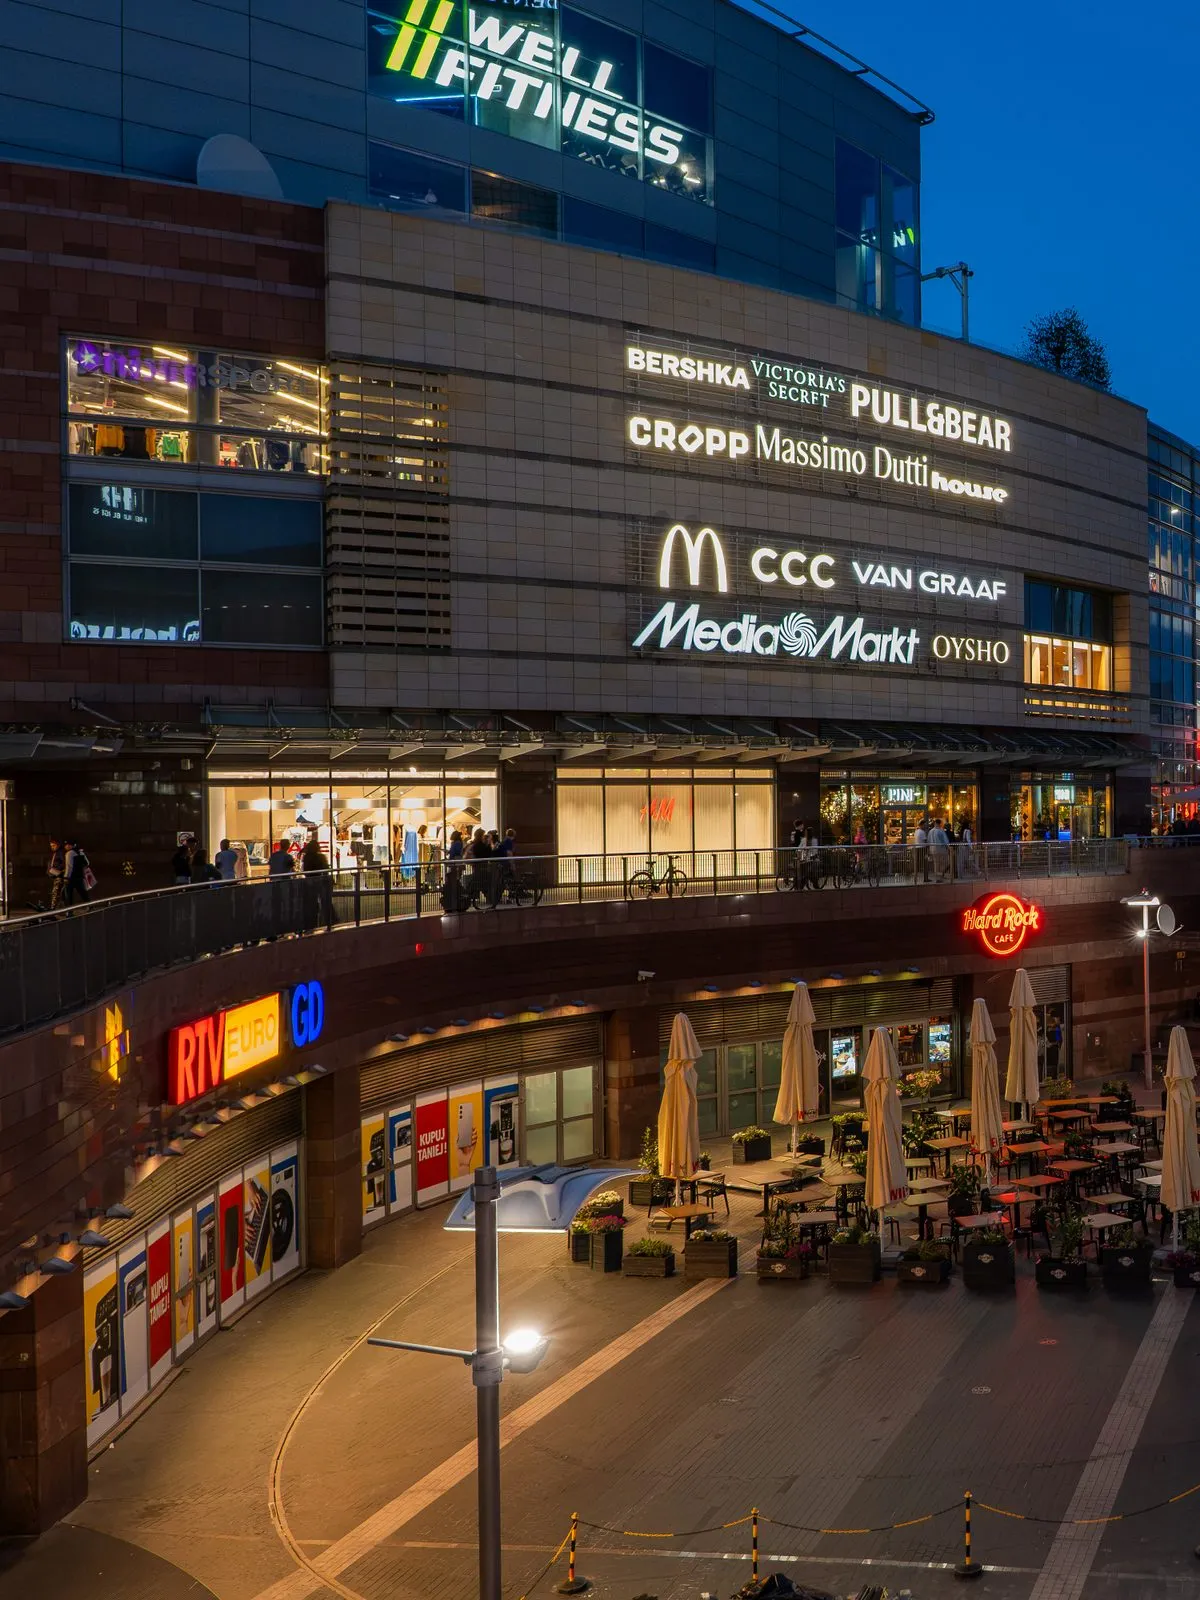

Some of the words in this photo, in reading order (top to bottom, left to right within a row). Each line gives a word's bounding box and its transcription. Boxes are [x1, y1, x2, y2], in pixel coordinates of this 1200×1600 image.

[468, 9, 624, 100] WELL
[435, 48, 684, 165] FITNESS
[626, 347, 750, 389] BERSHKA
[750, 359, 846, 393] VICTORIA'S
[851, 383, 1012, 452] PULL&BEAR
[629, 416, 750, 459] CROPP
[755, 425, 867, 475] Massimo
[874, 446, 929, 487] Dutti
[931, 471, 1010, 503] house
[751, 547, 836, 589] CCC
[852, 561, 912, 590] VAN
[919, 570, 1007, 601] GRAAF
[932, 634, 1010, 665] OYSHO
[963, 907, 1003, 930] Hard
[1004, 905, 1039, 931] Rock
[994, 934, 1014, 943] CAFE
[177, 1009, 226, 1105] RTV
[227, 1012, 276, 1059] EURO
[417, 1142, 448, 1162] TANIEJ!
[419, 1127, 446, 1147] KUPUJ
[150, 1271, 169, 1303] KUPUJ
[149, 1294, 171, 1326] TANIEJ!
